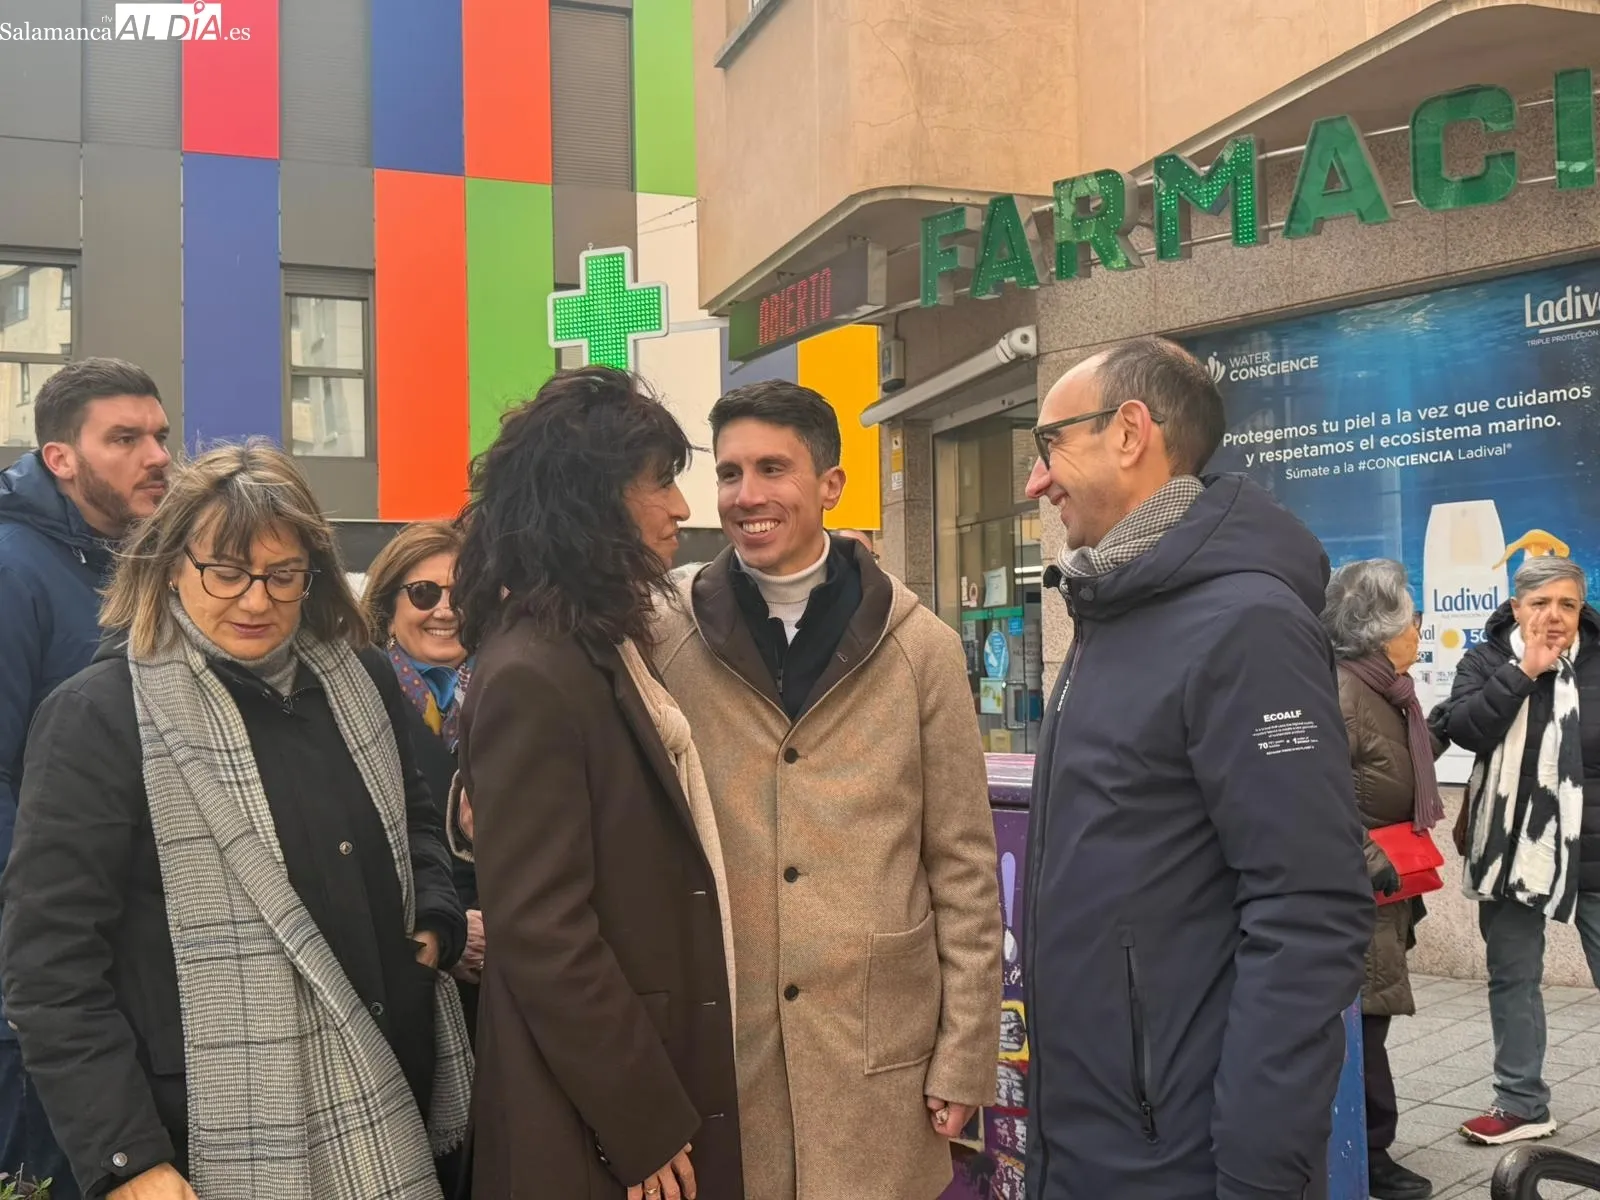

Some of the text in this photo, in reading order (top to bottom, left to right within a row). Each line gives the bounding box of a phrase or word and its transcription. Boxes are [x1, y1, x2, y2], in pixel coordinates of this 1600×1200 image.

[920, 67, 1596, 308] FARMACI
[1524, 284, 1600, 328] Ladiv
[1527, 337, 1551, 348] TRIPLE
[1228, 351, 1271, 368] WATER
[1229, 355, 1319, 382] CONSCIENCE
[1222, 385, 1592, 447] Protegemos tu piel a la vez que cuidamos
[1245, 414, 1562, 468] y respetamos el ecosistema marino.
[1285, 464, 1330, 480] Súmate
[1333, 465, 1340, 475] a
[1343, 462, 1354, 473] la
[1358, 449, 1454, 471] #CONCIENCIA
[1433, 585, 1499, 613] Ladival
[1263, 709, 1302, 723] ECOALF
